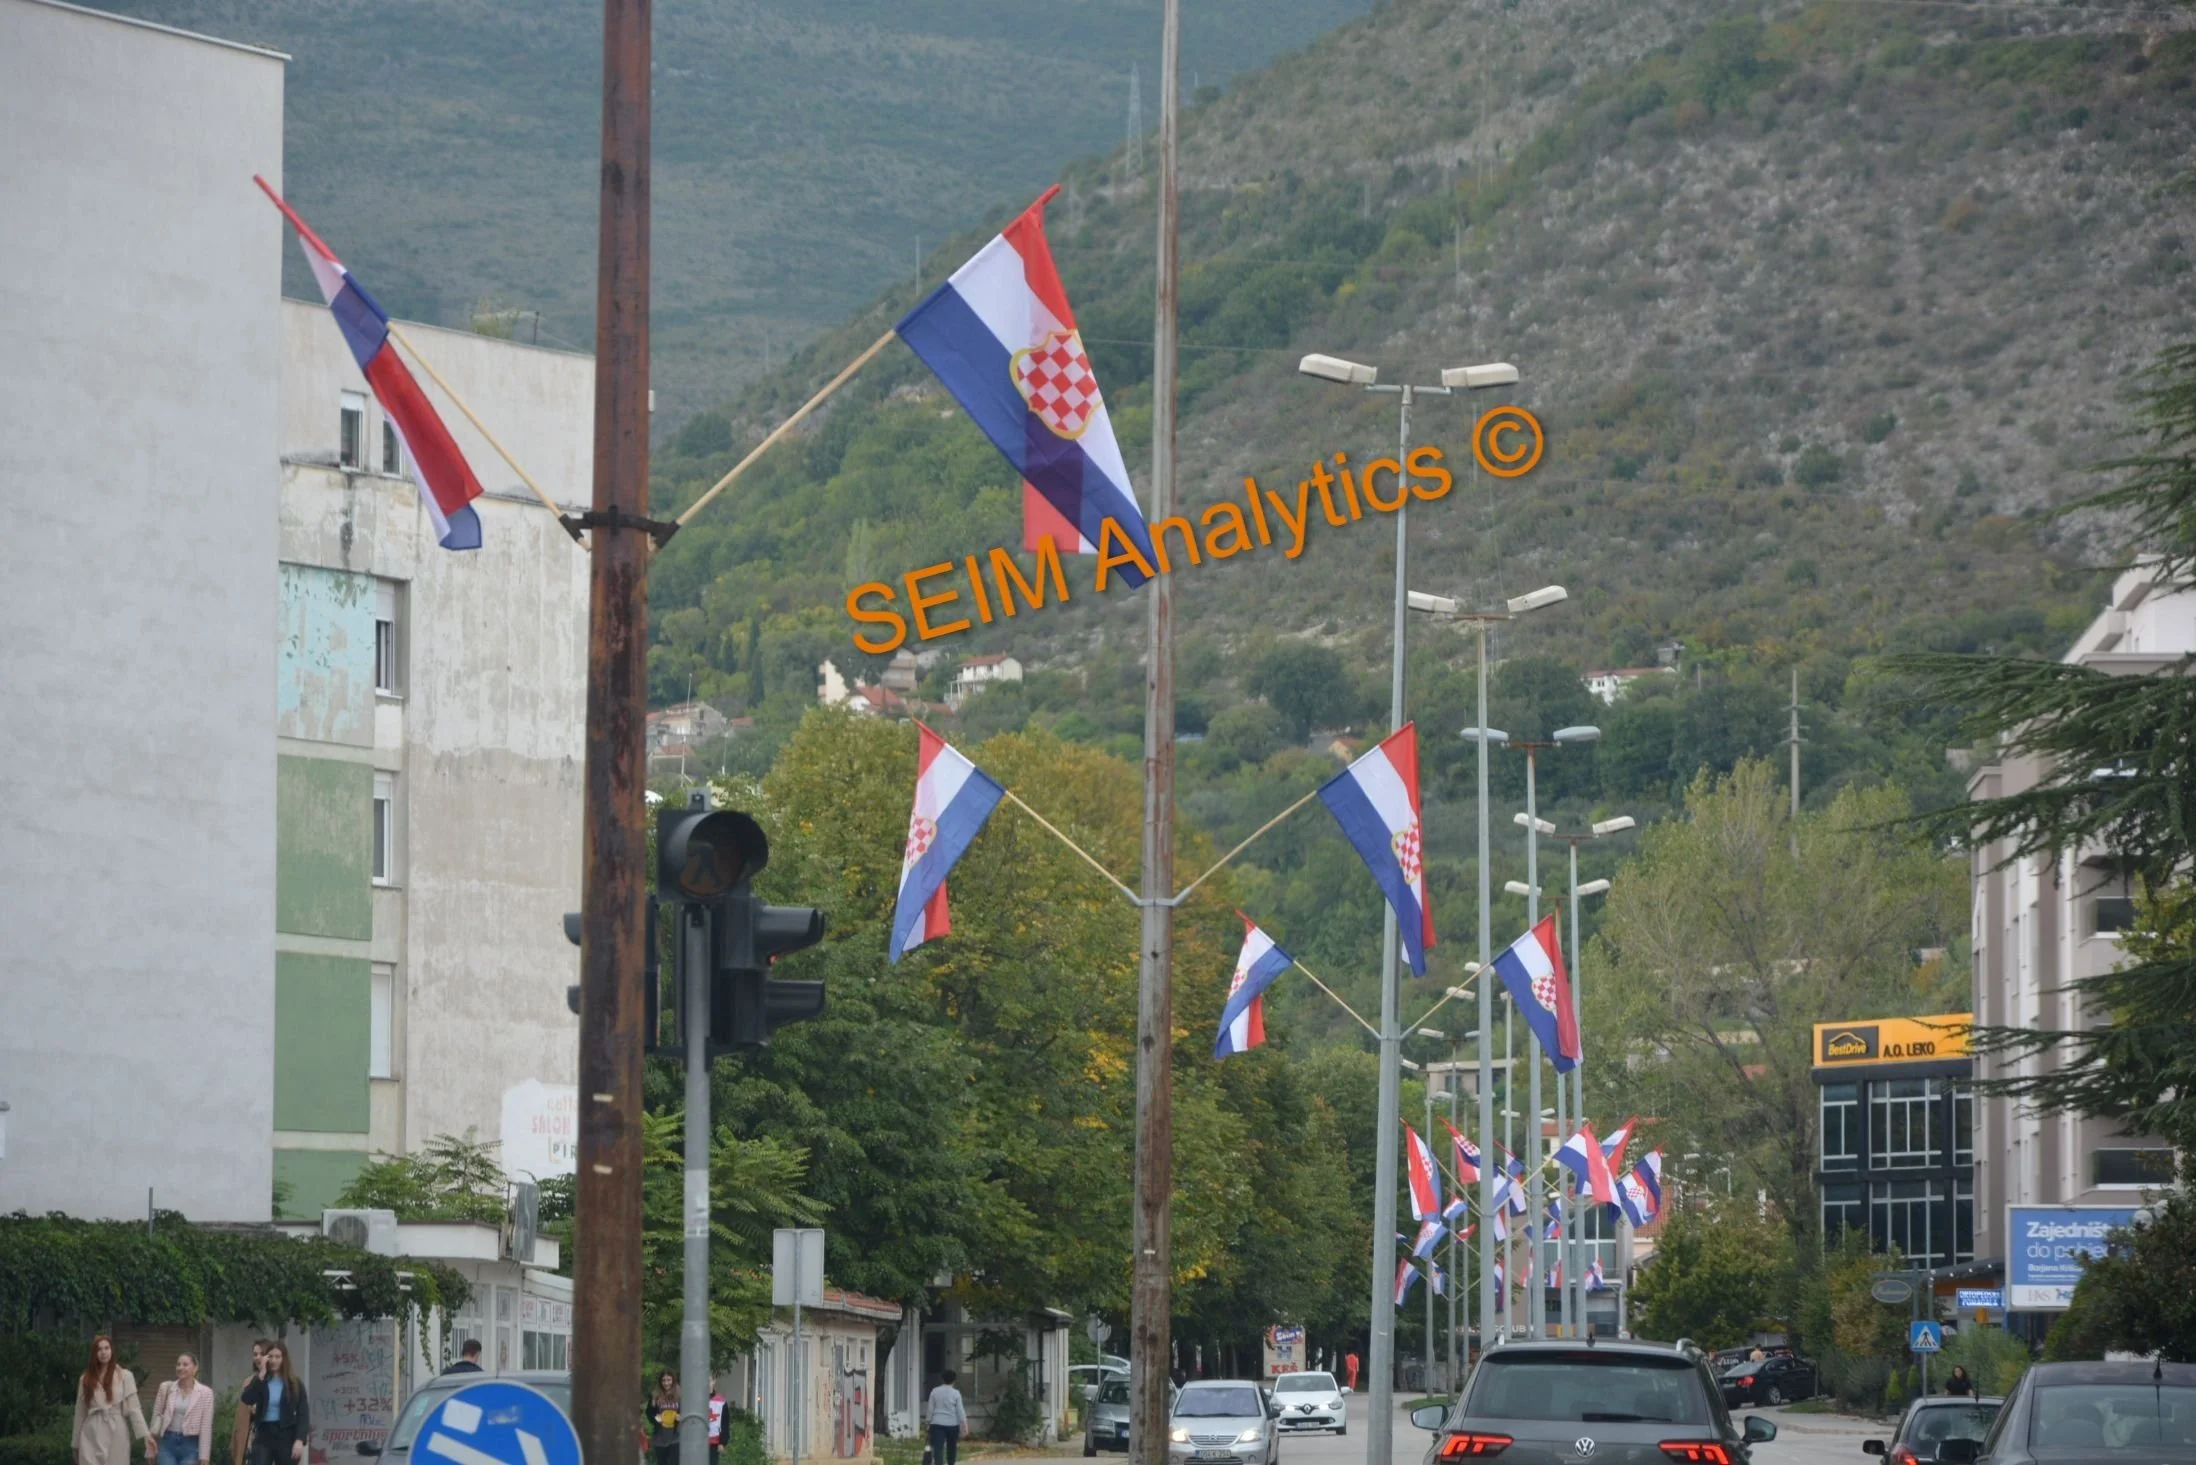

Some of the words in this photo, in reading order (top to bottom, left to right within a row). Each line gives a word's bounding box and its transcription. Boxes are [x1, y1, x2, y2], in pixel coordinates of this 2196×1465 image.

[1828, 1042, 1867, 1057] BestDrive
[1883, 1044, 1905, 1058] A.O.
[1906, 1041, 1936, 1057] LEKO
[2027, 1241, 2051, 1258] do
[343, 1398, 393, 1412] +32%
